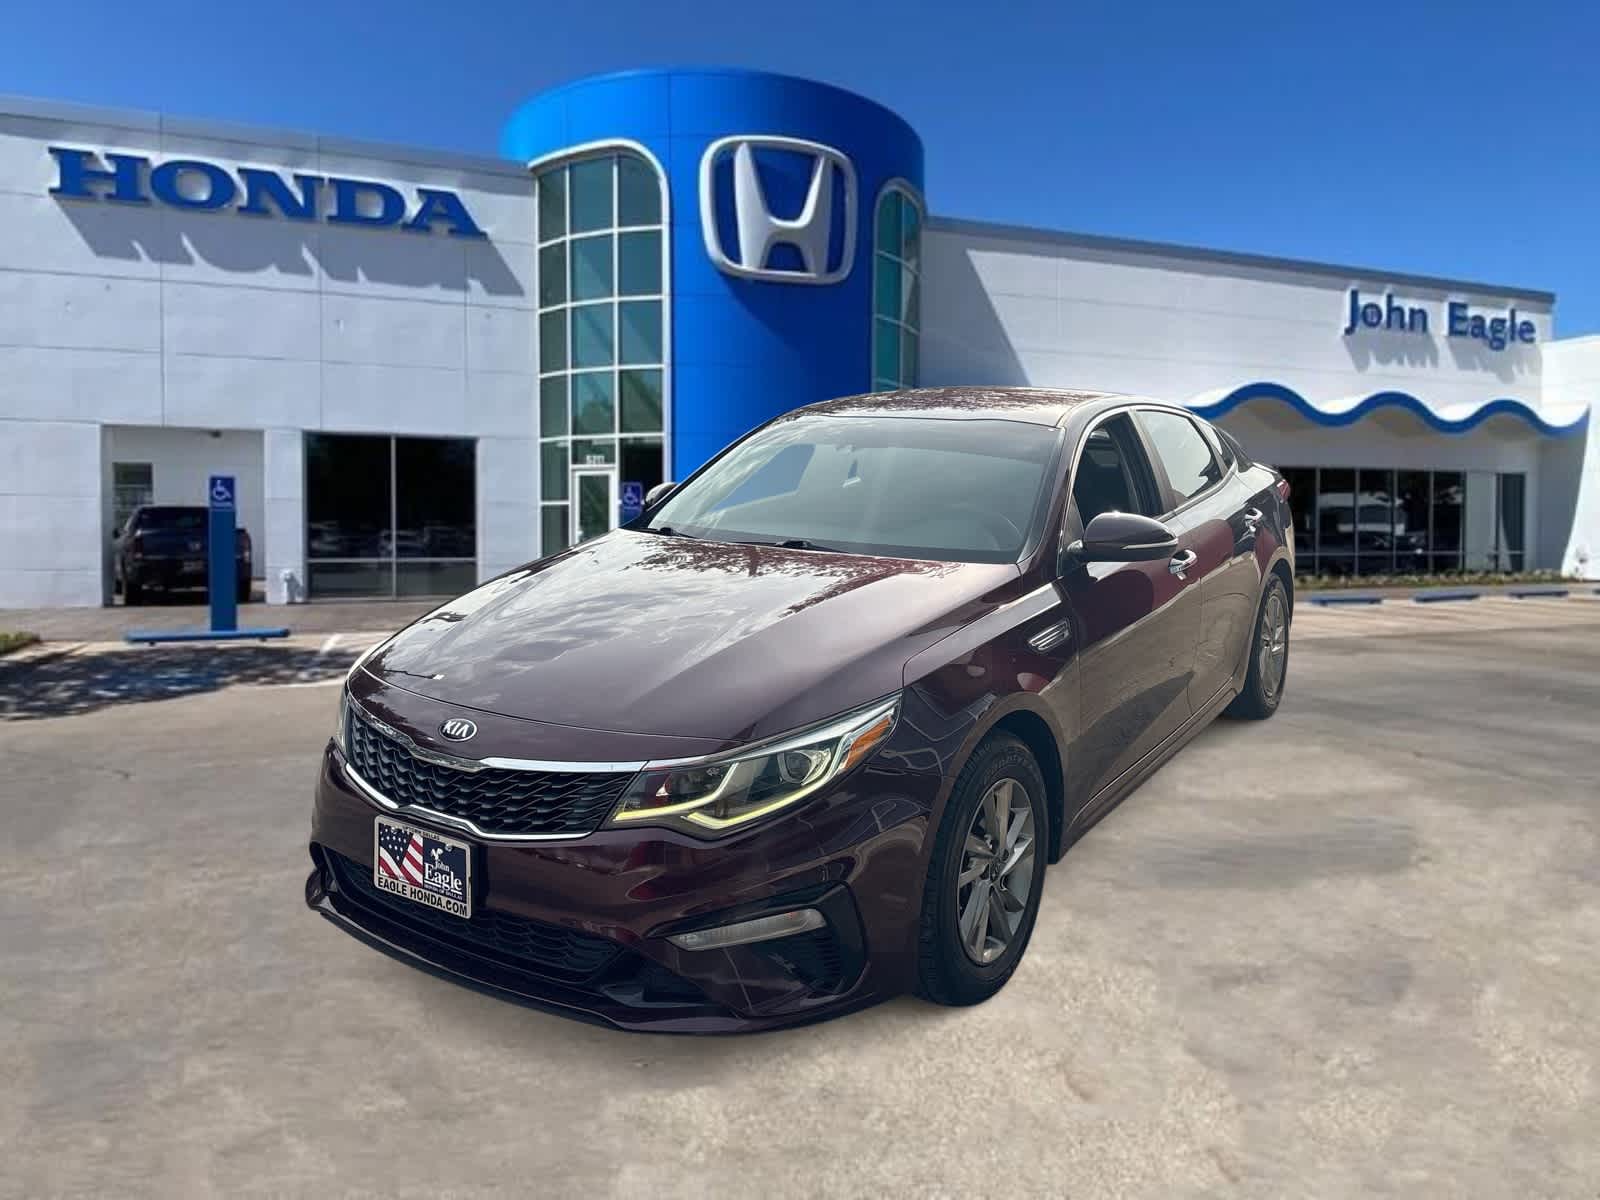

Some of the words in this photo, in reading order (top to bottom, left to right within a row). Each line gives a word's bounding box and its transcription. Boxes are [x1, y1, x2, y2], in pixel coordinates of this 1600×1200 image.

[48, 146, 488, 240] HONDA
[1344, 289, 1429, 336] John
[1448, 302, 1536, 351] Eagle
[442, 720, 470, 737] KIA
[424, 862, 463, 892] Eagle
[434, 859, 450, 873] John
[377, 877, 408, 897] EAGLE
[410, 887, 468, 917] HONDA.COM
